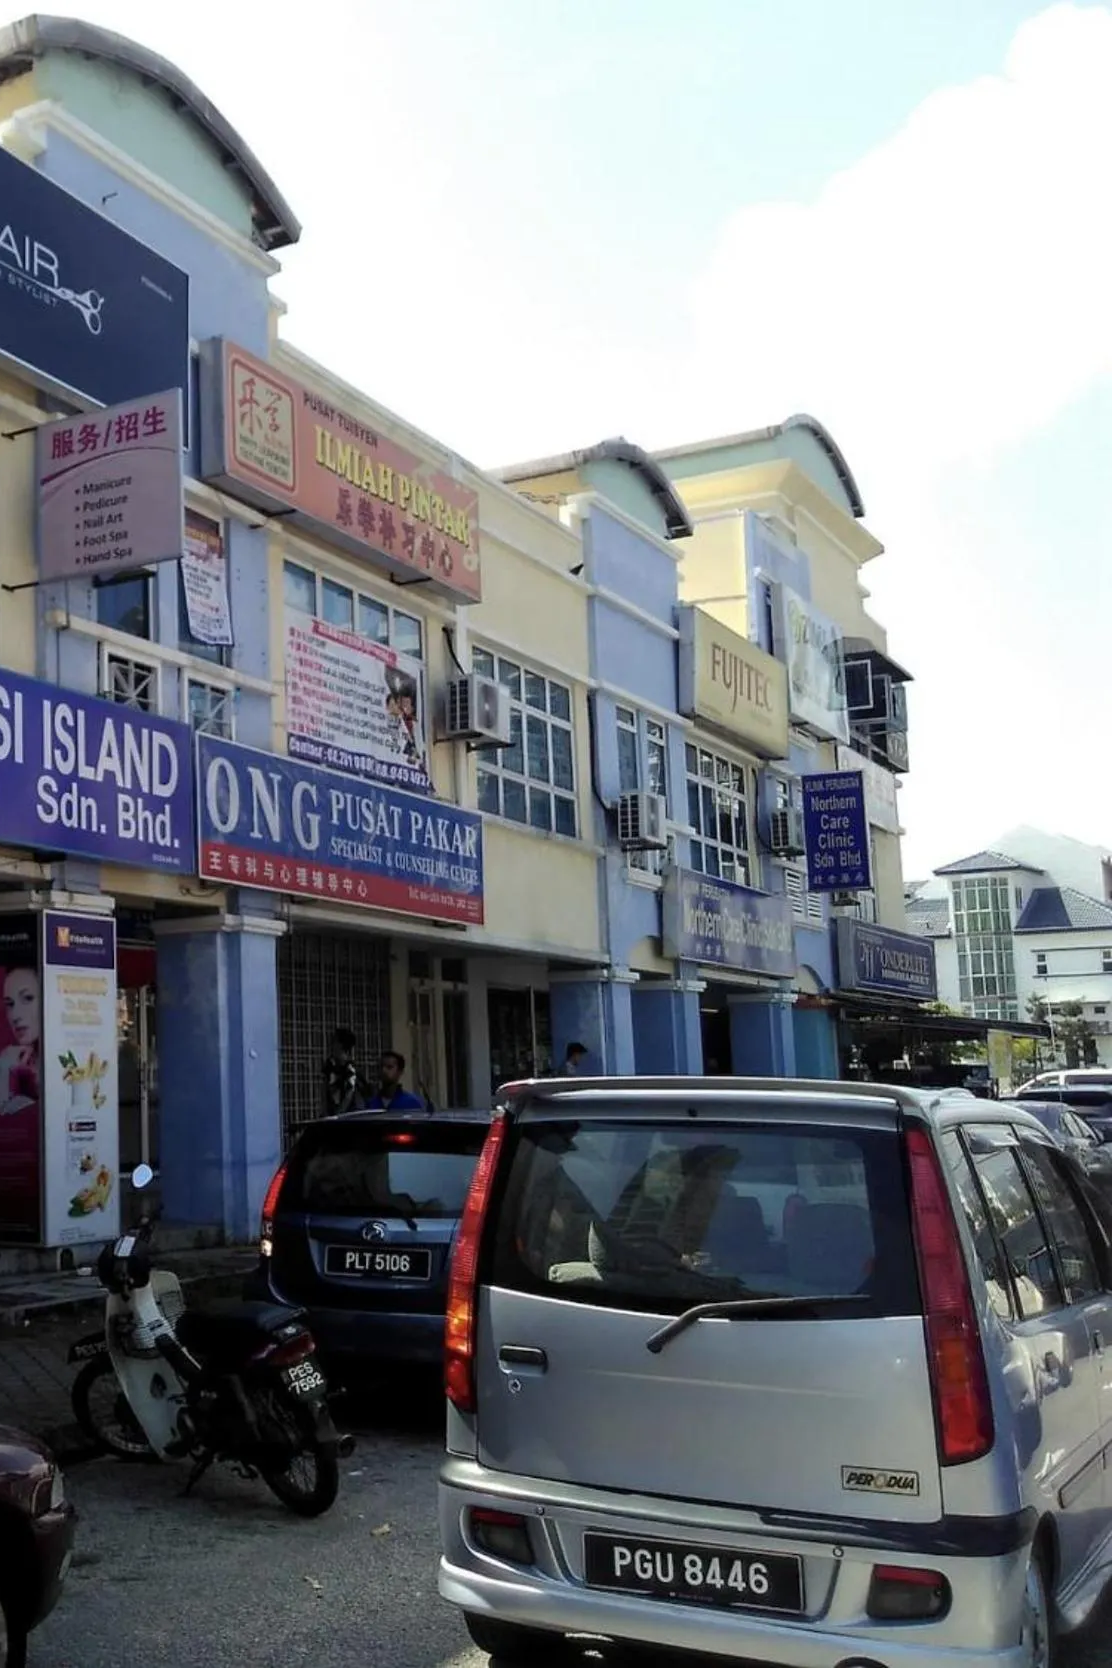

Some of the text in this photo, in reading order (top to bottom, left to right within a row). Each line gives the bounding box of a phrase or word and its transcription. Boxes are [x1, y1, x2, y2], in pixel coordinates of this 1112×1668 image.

[7, 273, 60, 307] STYLIST
[303, 391, 336, 423] PUSAT
[52, 406, 167, 459] 服务/招生
[82, 475, 132, 496] Manicure
[315, 424, 395, 505] ILMIAH
[398, 474, 470, 548] PINTAR
[82, 494, 128, 513] Pedicure
[83, 512, 123, 530] Nail Art
[83, 529, 128, 548] Foot Spa
[83, 546, 132, 565] Hand Spa
[43, 699, 179, 798] ISLAND
[36, 774, 181, 848] Sdn. Bhd.
[206, 756, 478, 859] ONG PUSAT PAKAR
[810, 795, 857, 812] Northern
[820, 814, 850, 830] Care
[330, 836, 383, 865] SPECIALIST
[817, 832, 855, 849] Clinic
[814, 850, 861, 868] Sdn Bhd
[345, 1251, 410, 1271] PLT 5106
[288, 1361, 314, 1381] PES
[845, 1471, 915, 1491] PERODUA
[612, 1546, 769, 1596] PGU 8446
